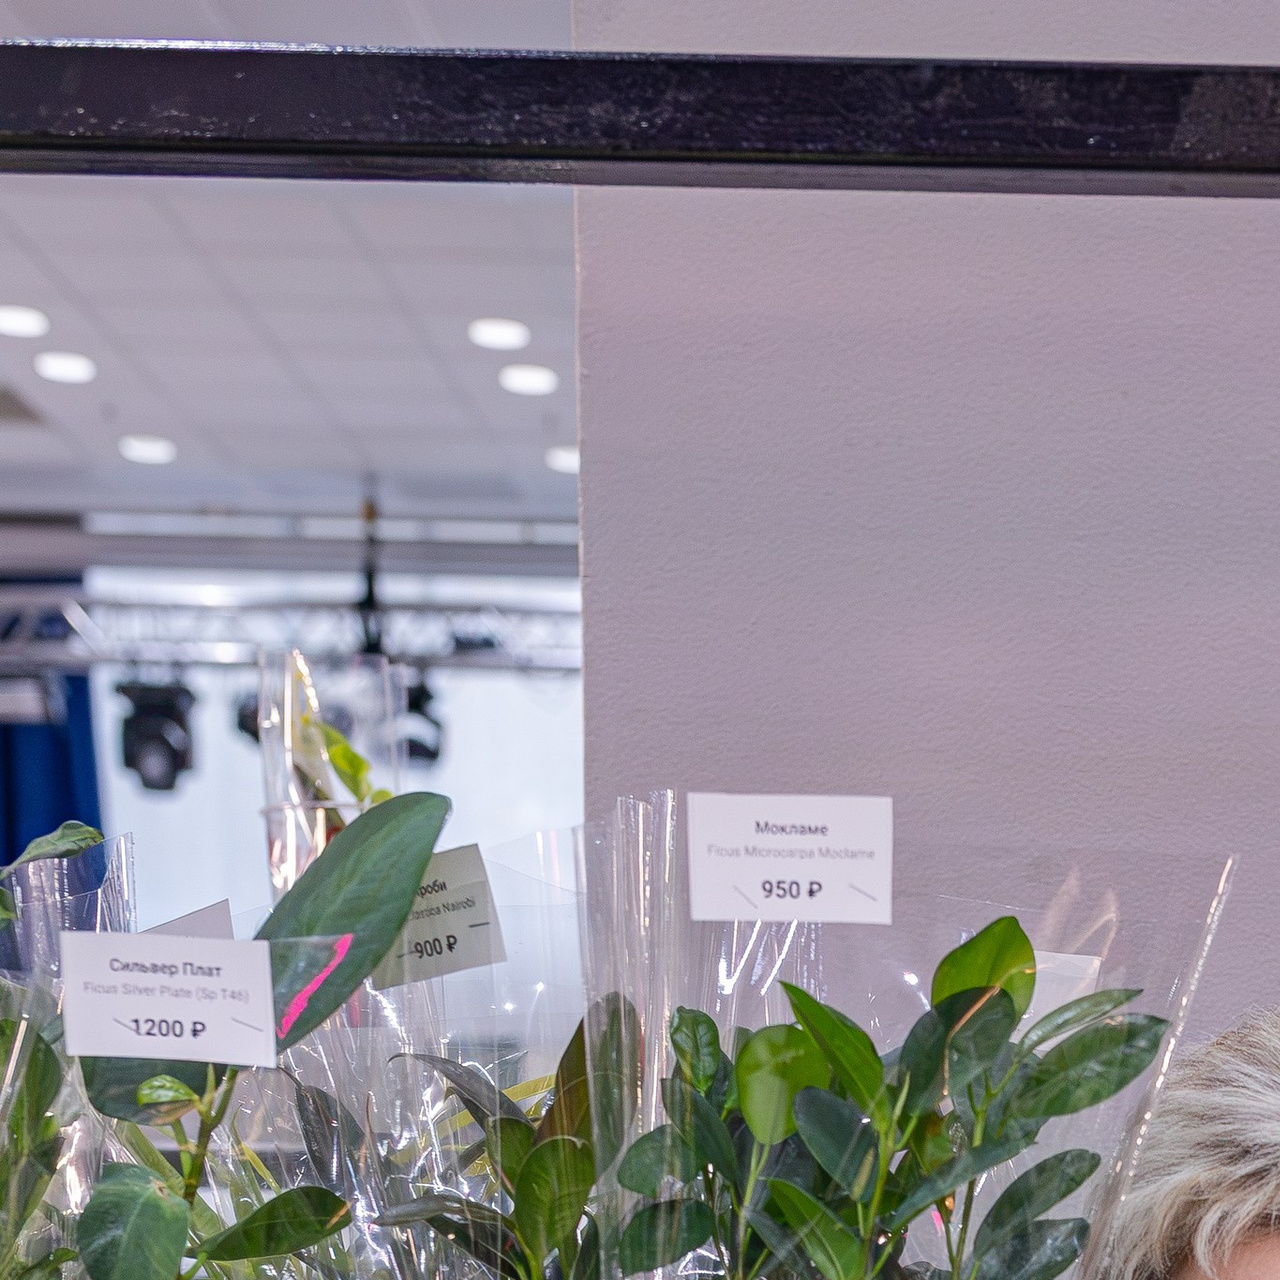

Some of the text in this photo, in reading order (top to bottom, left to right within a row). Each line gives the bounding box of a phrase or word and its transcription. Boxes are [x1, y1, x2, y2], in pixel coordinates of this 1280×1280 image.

[755, 821, 828, 836] Мокламе
[762, 880, 800, 899] 950
[414, 937, 443, 959] 900
[110, 958, 222, 977] Сильвер Плат
[131, 1018, 184, 1037] 1200
